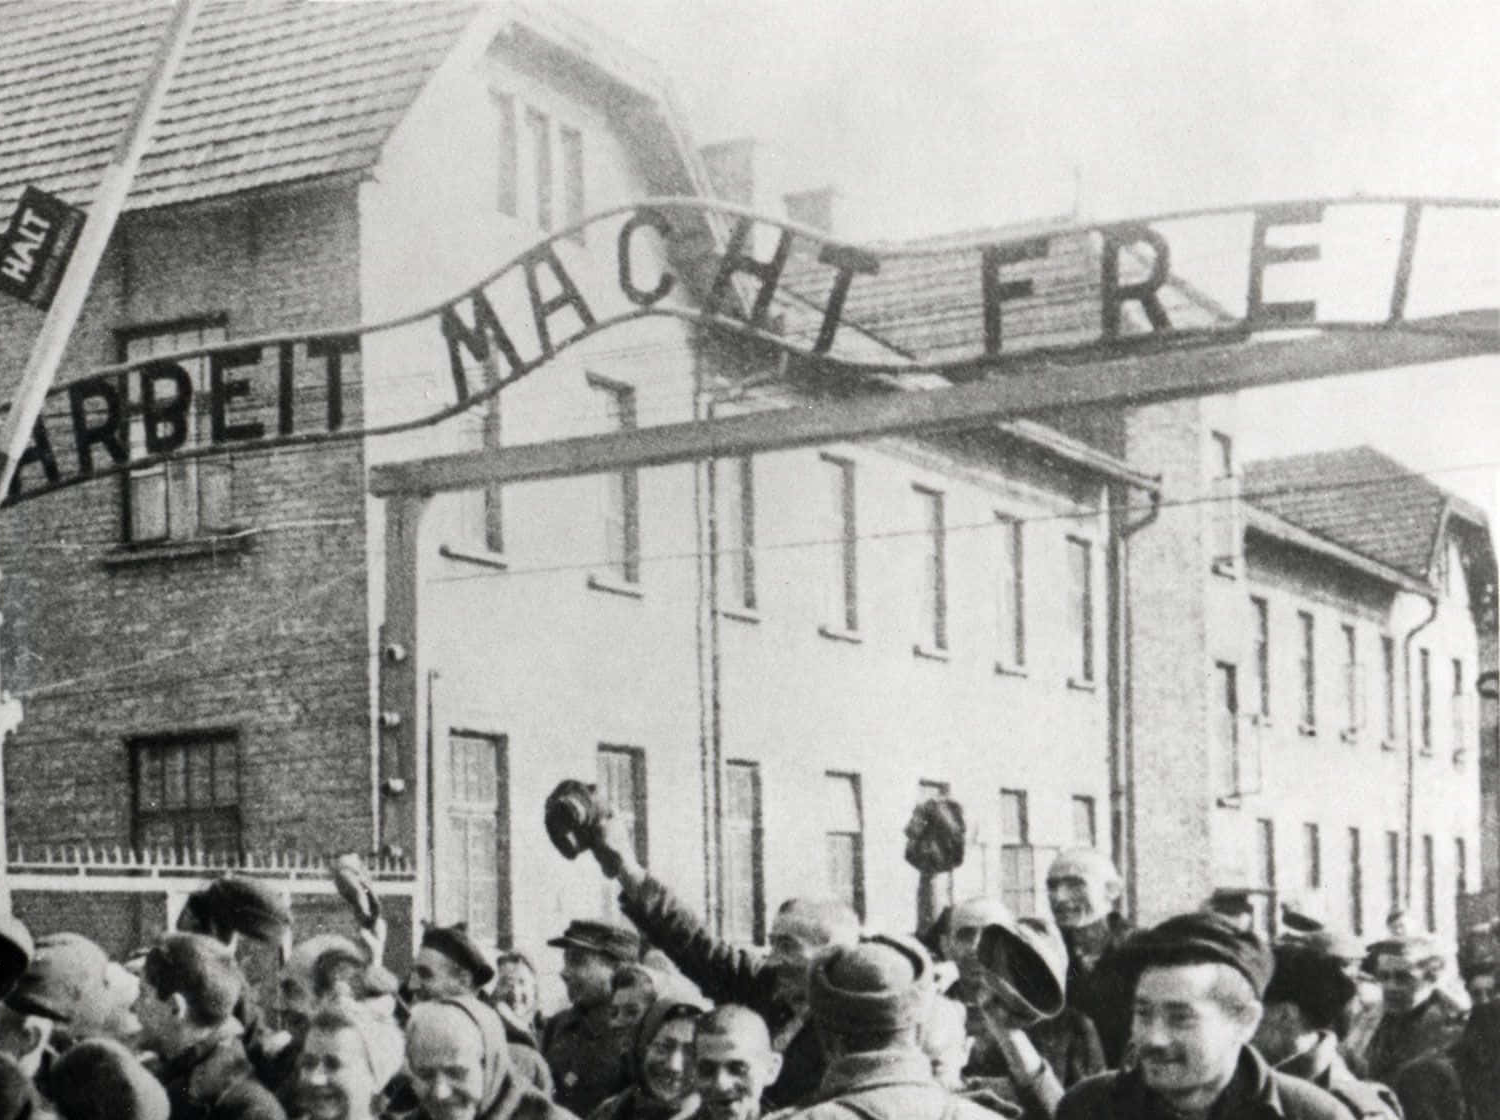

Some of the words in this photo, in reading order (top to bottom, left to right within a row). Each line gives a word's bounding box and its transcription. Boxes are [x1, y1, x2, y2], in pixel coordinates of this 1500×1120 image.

[0, 207, 51, 283] HALT
[441, 205, 881, 402] MACHT
[982, 200, 1423, 358] FREI
